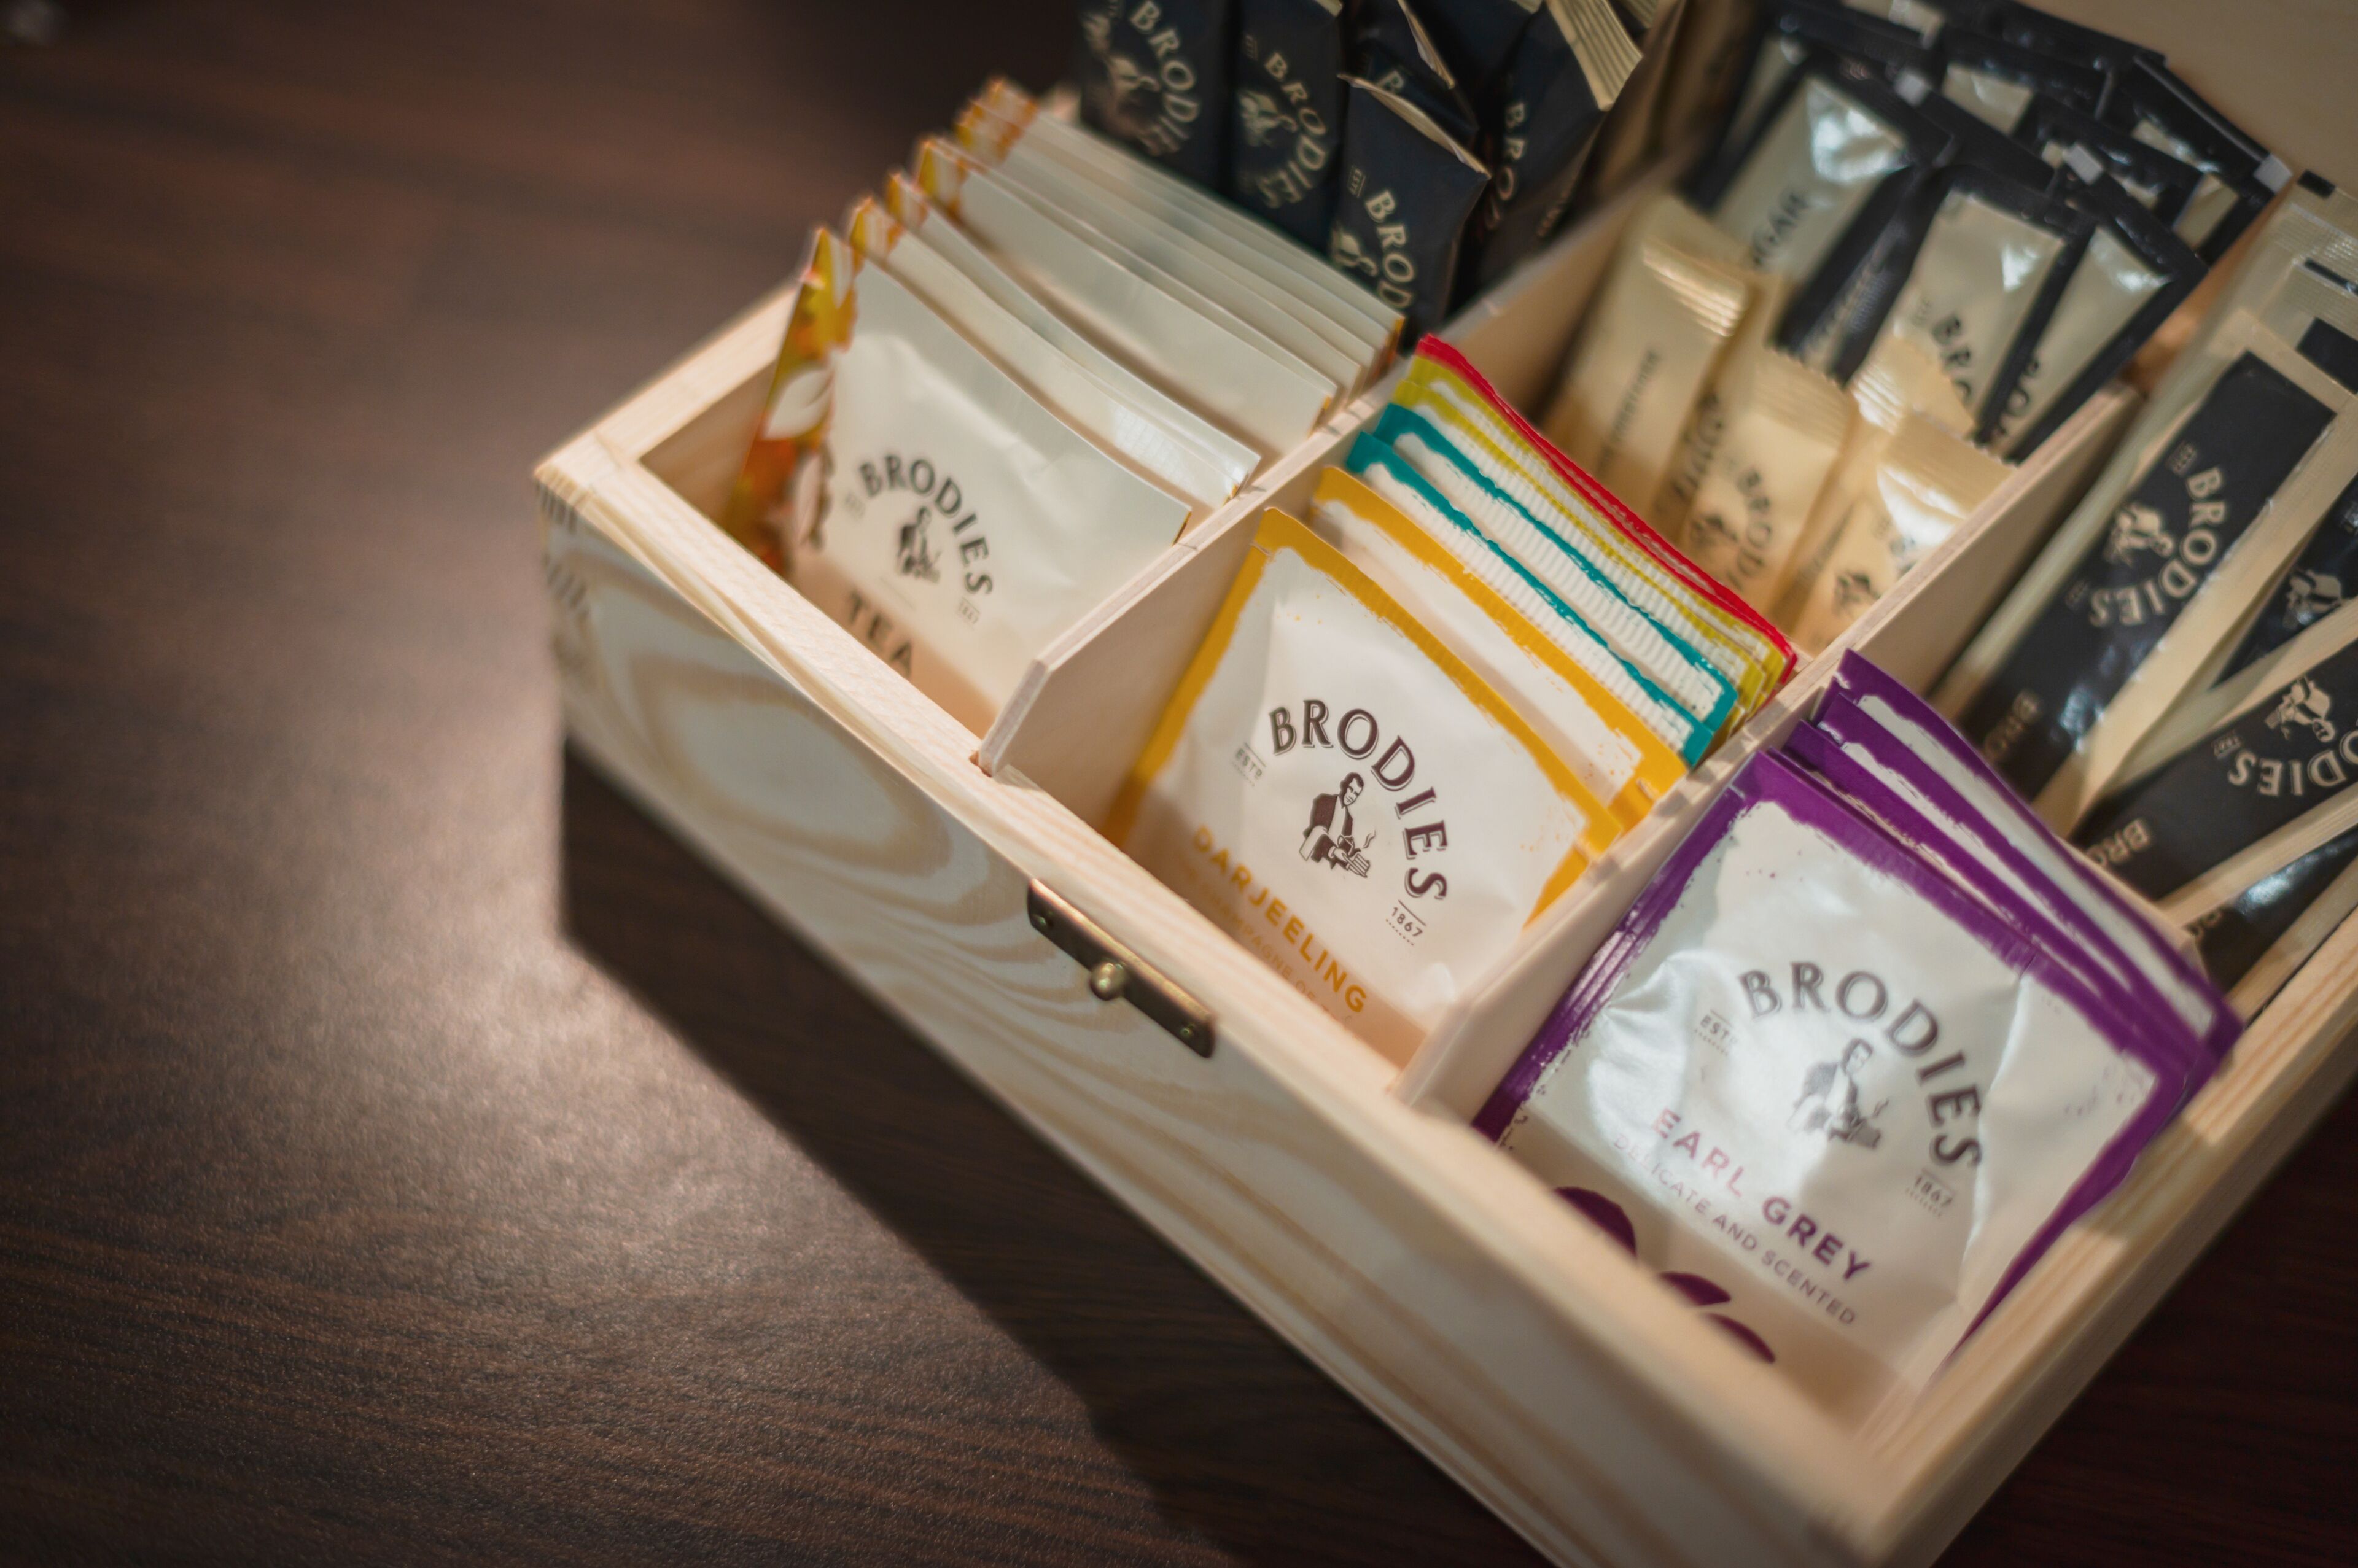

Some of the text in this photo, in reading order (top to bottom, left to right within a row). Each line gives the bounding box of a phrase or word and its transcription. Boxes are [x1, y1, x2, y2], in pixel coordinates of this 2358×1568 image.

[1365, 189, 1414, 308] BROD
[859, 453, 993, 596] BRODIES
[2090, 467, 2227, 626] BRODIES
[849, 590, 912, 678] TEA
[1269, 699, 1448, 900] BRODIES
[2227, 728, 2358, 796] ODIES
[1191, 825, 1367, 1013] DARJEELING
[1391, 907, 1423, 937] 1867
[1737, 960, 1983, 1170] BRODIES
[1613, 1133, 1856, 1324] DELICATE AND SCENTED
[1652, 1108, 1871, 1281] EARL GREY
[1915, 1175, 1953, 1208] 1867
